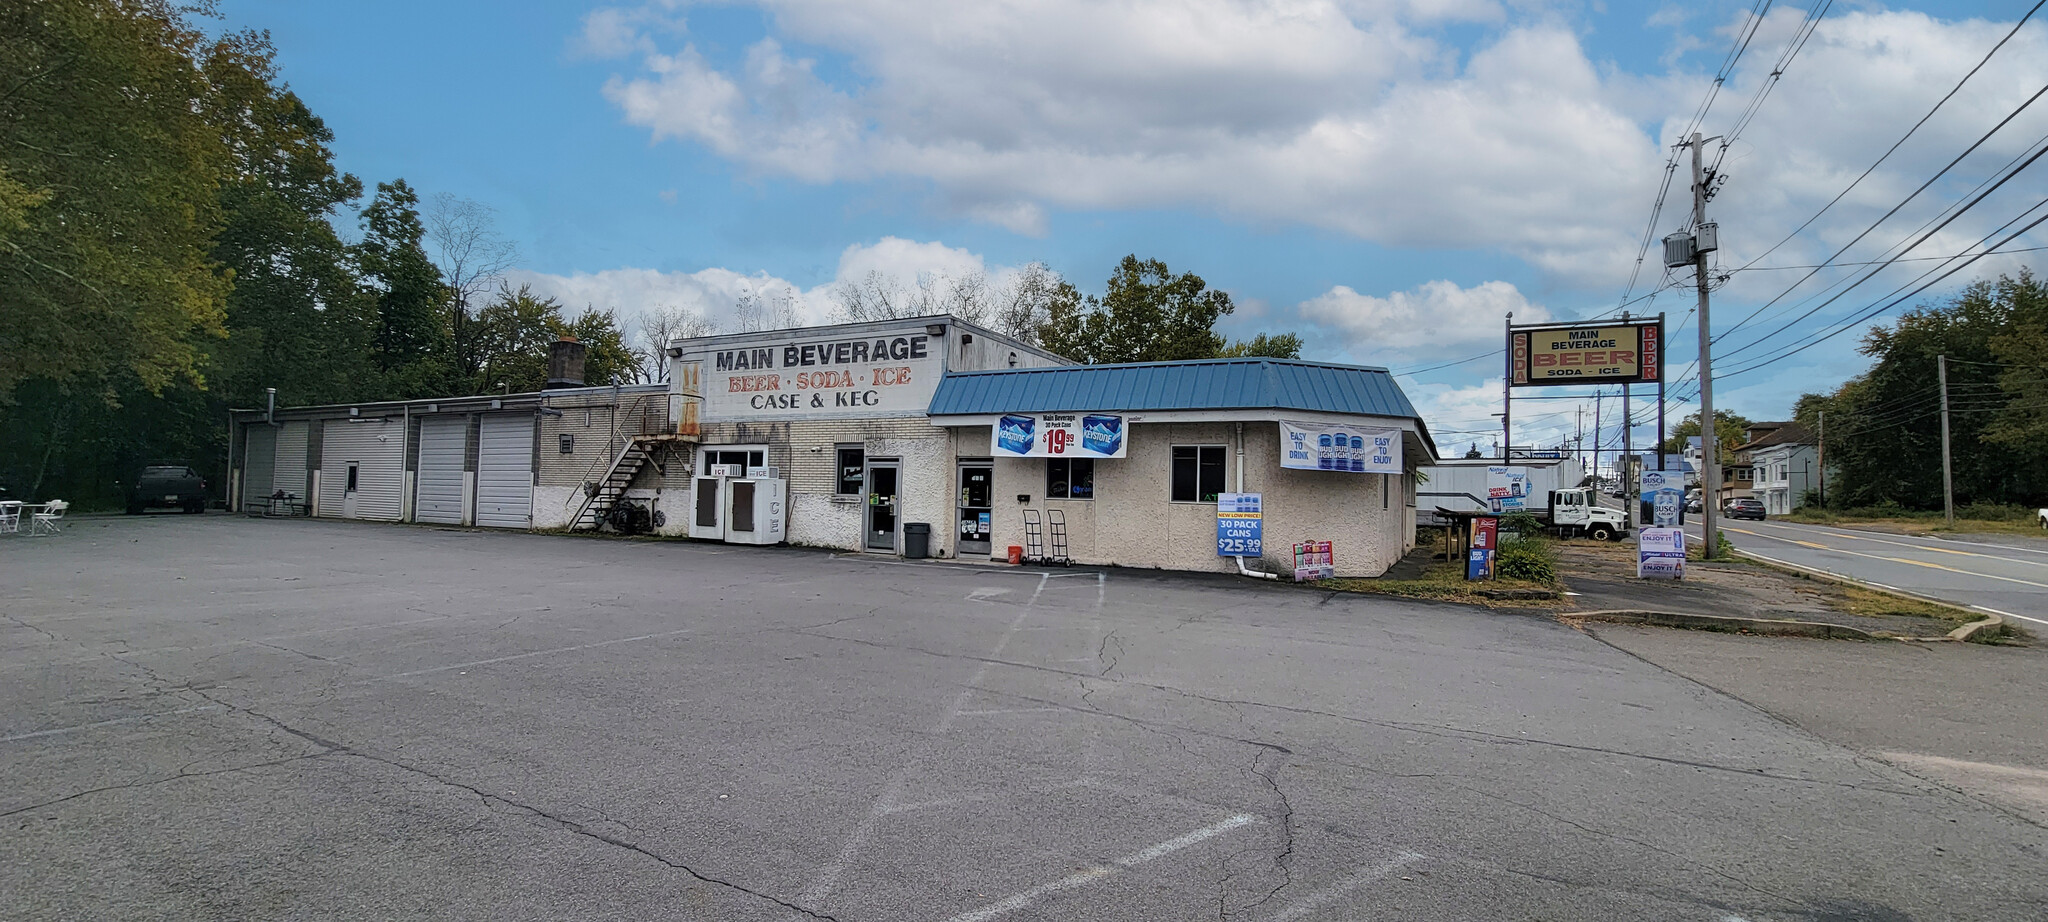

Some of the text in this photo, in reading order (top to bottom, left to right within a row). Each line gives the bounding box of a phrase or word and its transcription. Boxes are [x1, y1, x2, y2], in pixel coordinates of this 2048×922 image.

[1568, 330, 1598, 340] MAIN
[1552, 340, 1616, 350] BEVERAGE
[716, 336, 928, 371] MAIN BEVERAGE
[1514, 335, 1526, 382] SODA
[1534, 351, 1635, 367] BEER
[1644, 327, 1656, 380] BEER
[728, 367, 912, 392] BEER SODA ICE
[750, 390, 879, 410] CASE & KEG
[1000, 430, 1025, 443] KEYSTONE
[1084, 430, 1112, 443] KEYSTONE
[1290, 432, 1306, 440] EASY
[1375, 438, 1390, 446] EASY
[1290, 451, 1308, 460] DRINK
[1379, 447, 1387, 455] TO
[1374, 455, 1392, 464] ENJOY
[770, 484, 780, 533] ICE
[1219, 538, 1260, 552] $25.99
